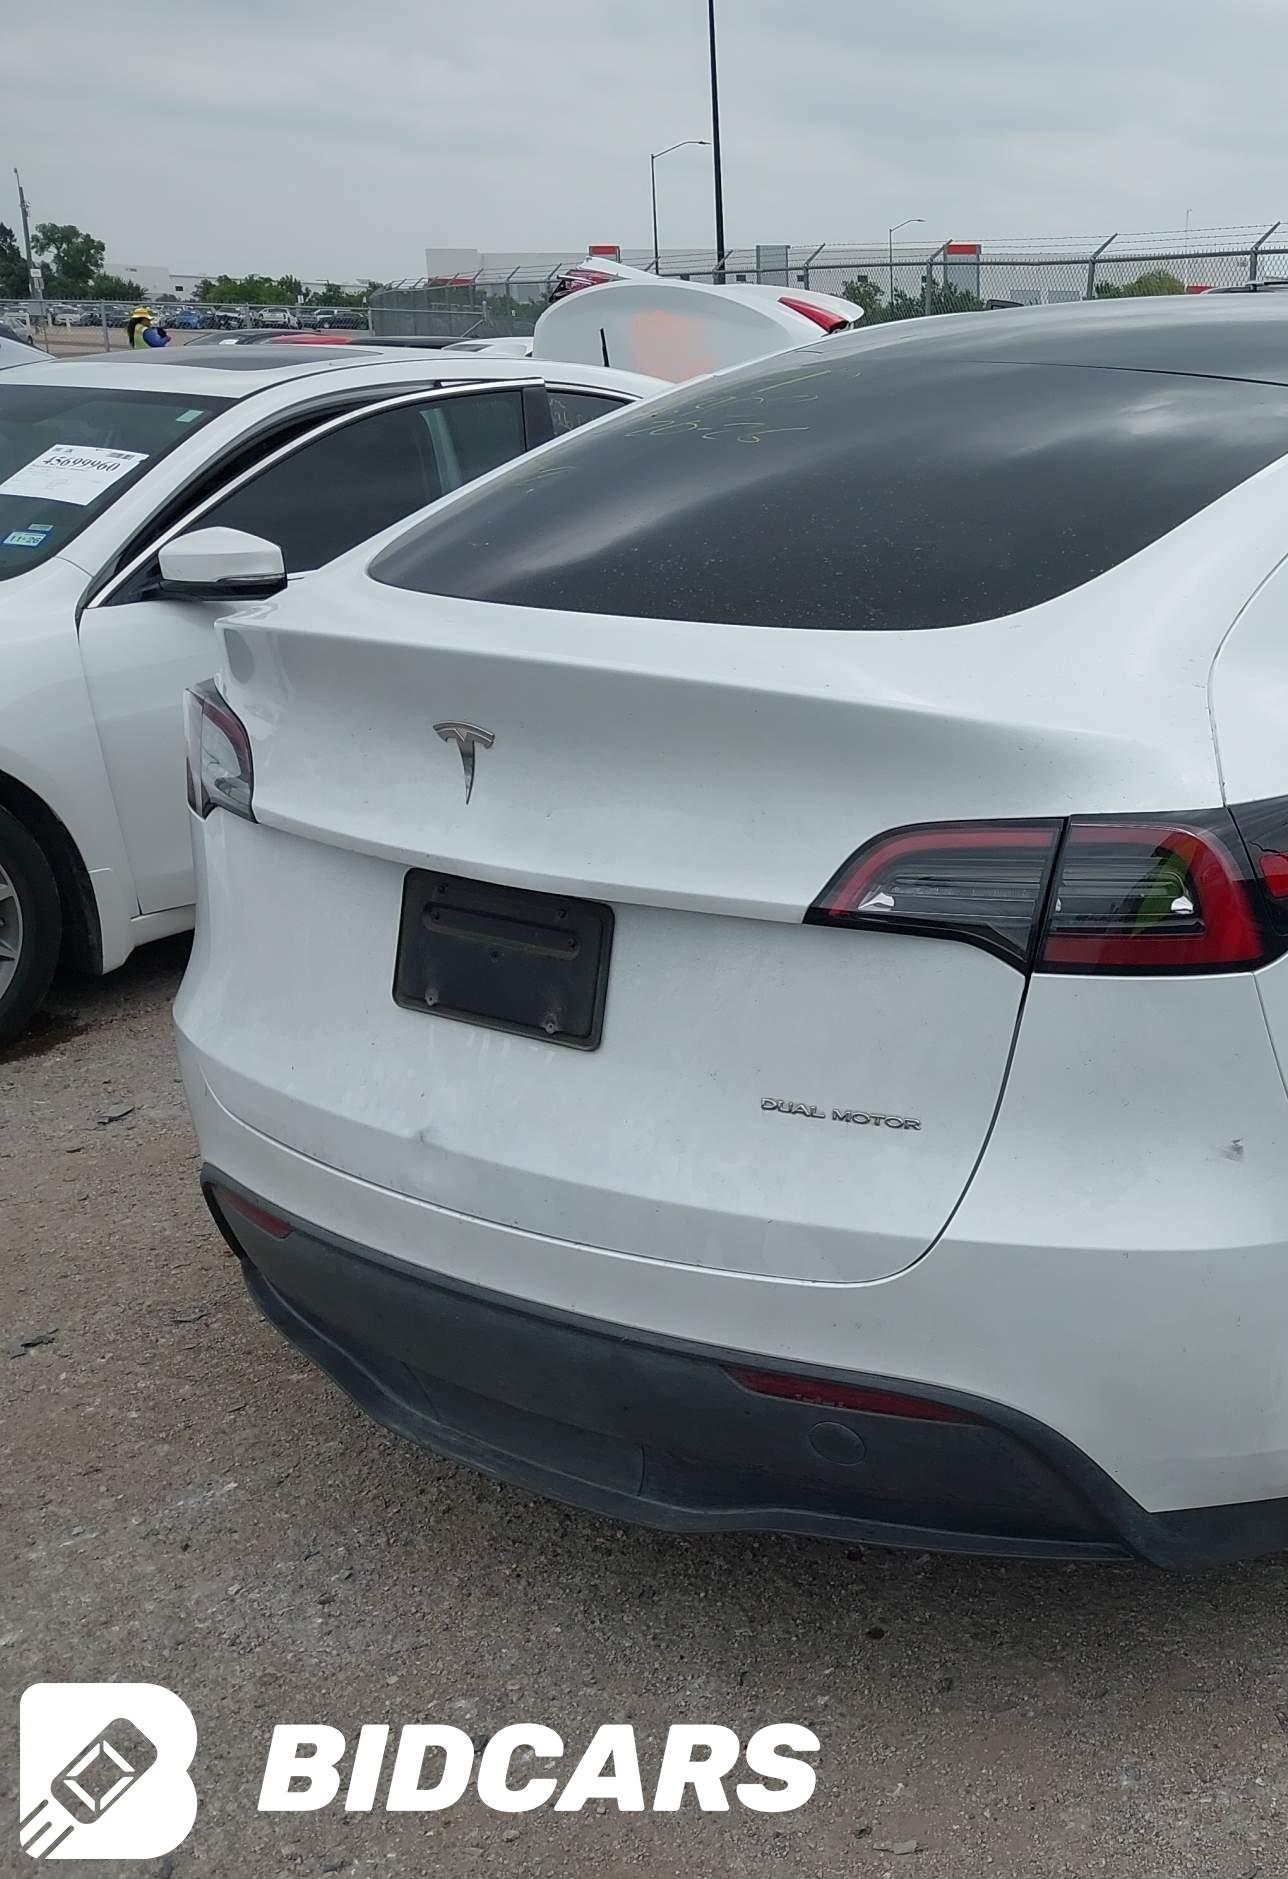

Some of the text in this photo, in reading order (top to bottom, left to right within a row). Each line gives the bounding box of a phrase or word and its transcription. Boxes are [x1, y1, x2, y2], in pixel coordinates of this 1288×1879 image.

[42, 455, 121, 473] 45699960
[761, 1098, 922, 1131] DUAL MOTOR
